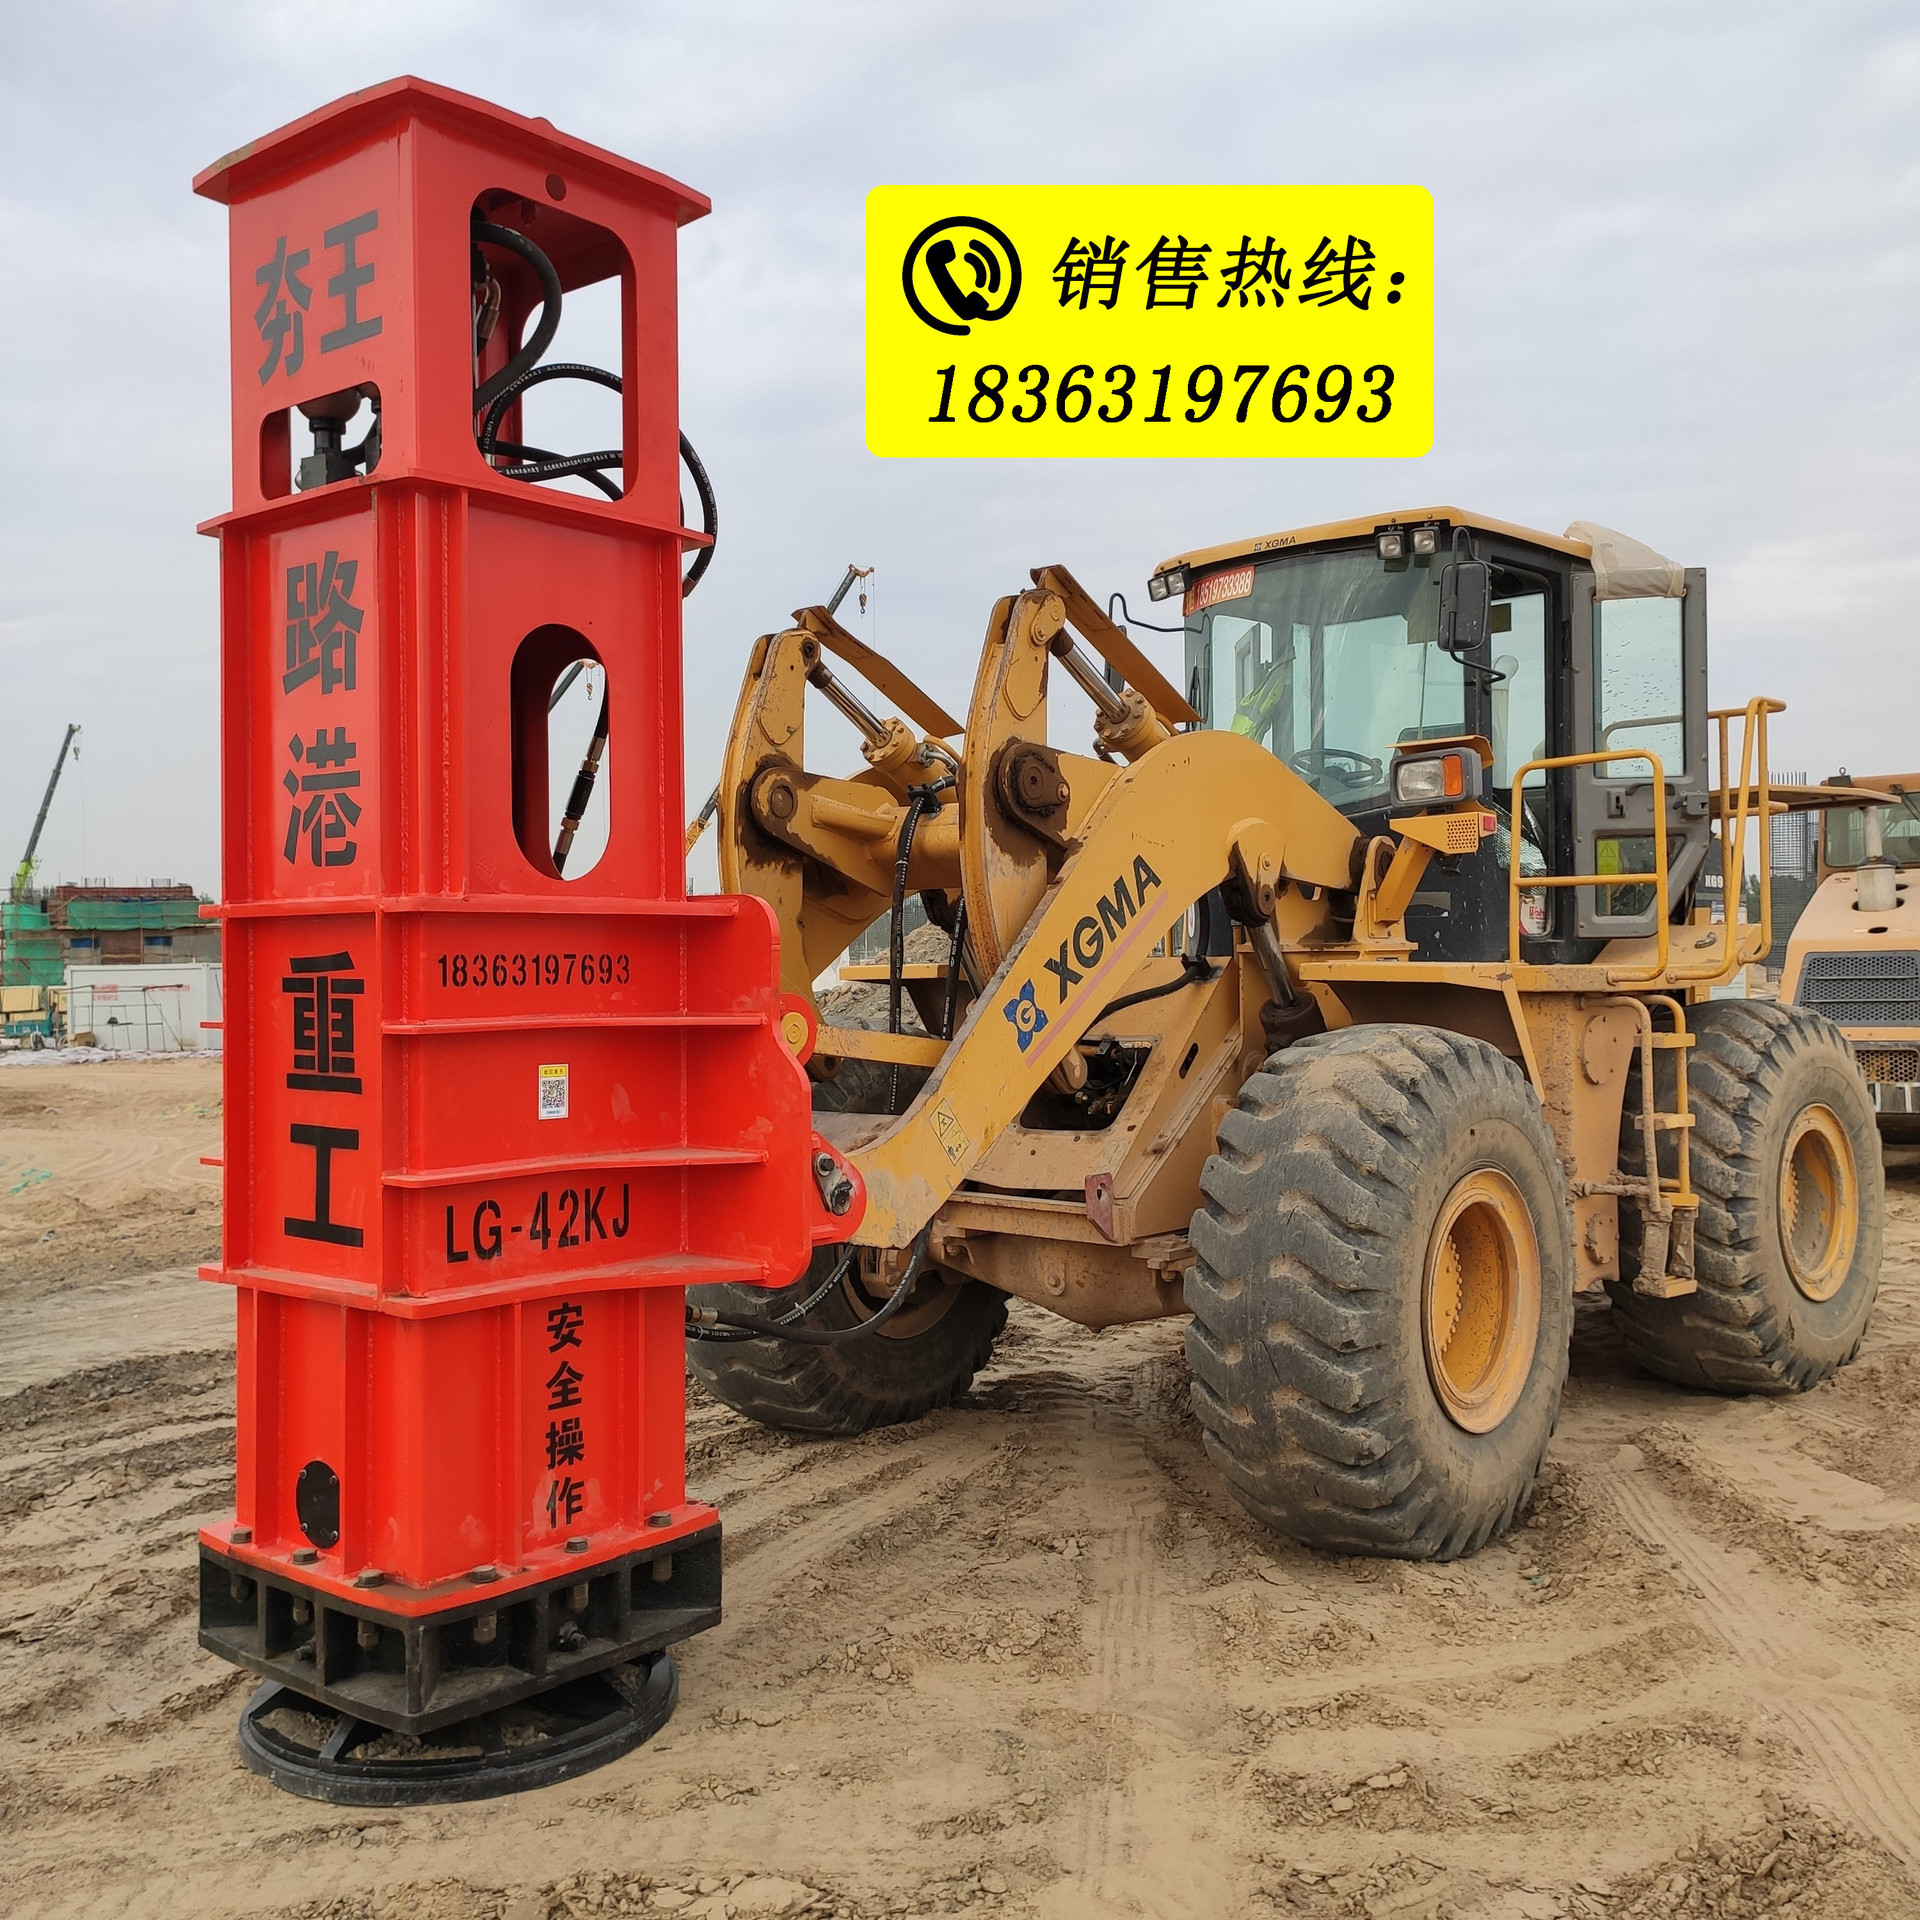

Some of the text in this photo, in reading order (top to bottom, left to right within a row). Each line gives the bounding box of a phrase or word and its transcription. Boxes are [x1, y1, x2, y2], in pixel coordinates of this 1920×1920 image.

[254, 208, 383, 386] 夯王
[1196, 570, 1253, 607] 18519733388
[1264, 536, 1296, 550] XGMA
[282, 551, 365, 1248] 路港重工
[1043, 854, 1162, 1005] XGMA
[437, 953, 631, 988] 18363197693
[445, 1183, 631, 1263] LG-42KJ
[546, 1301, 585, 1529] 安全操作
